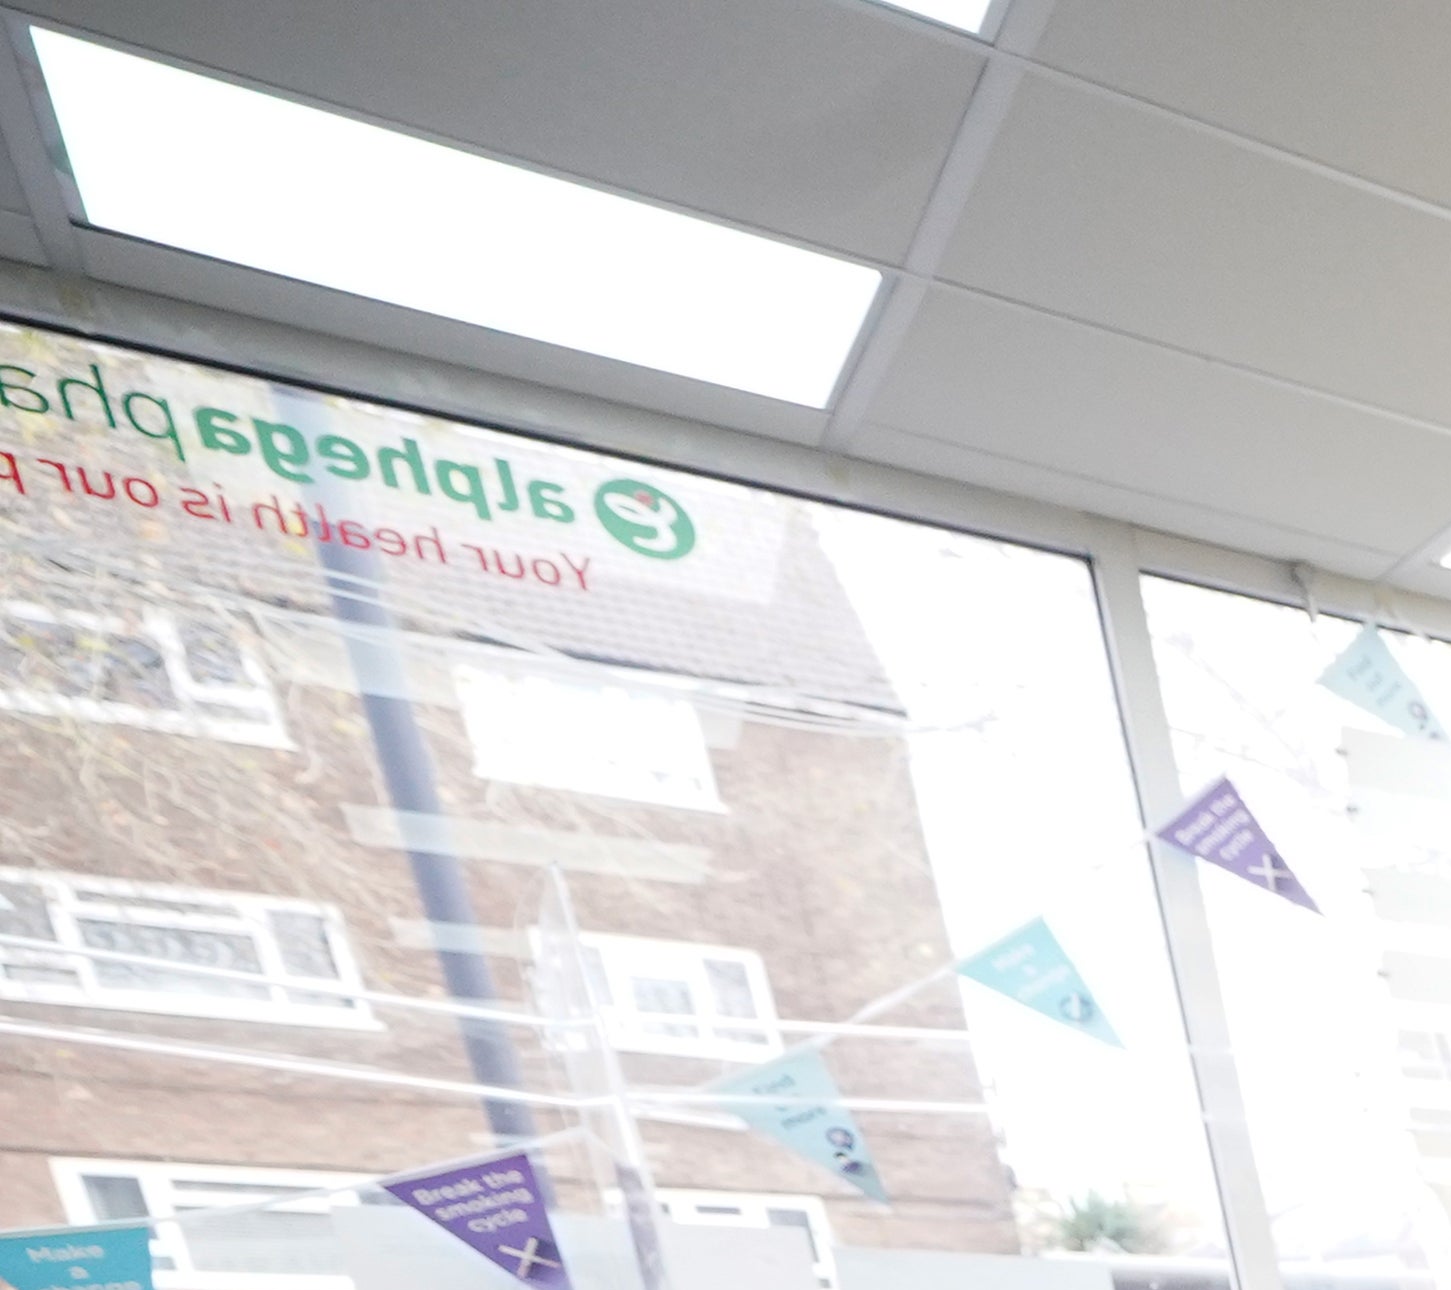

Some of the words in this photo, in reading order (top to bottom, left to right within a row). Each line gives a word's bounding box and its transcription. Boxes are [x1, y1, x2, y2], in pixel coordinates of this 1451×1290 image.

[412, 1178, 484, 1205] Break
[482, 1170, 524, 1189] the
[435, 1188, 534, 1221] smoking
[467, 1208, 528, 1233] cycle
[25, 1243, 106, 1264] Make
[70, 1266, 90, 1280] a
